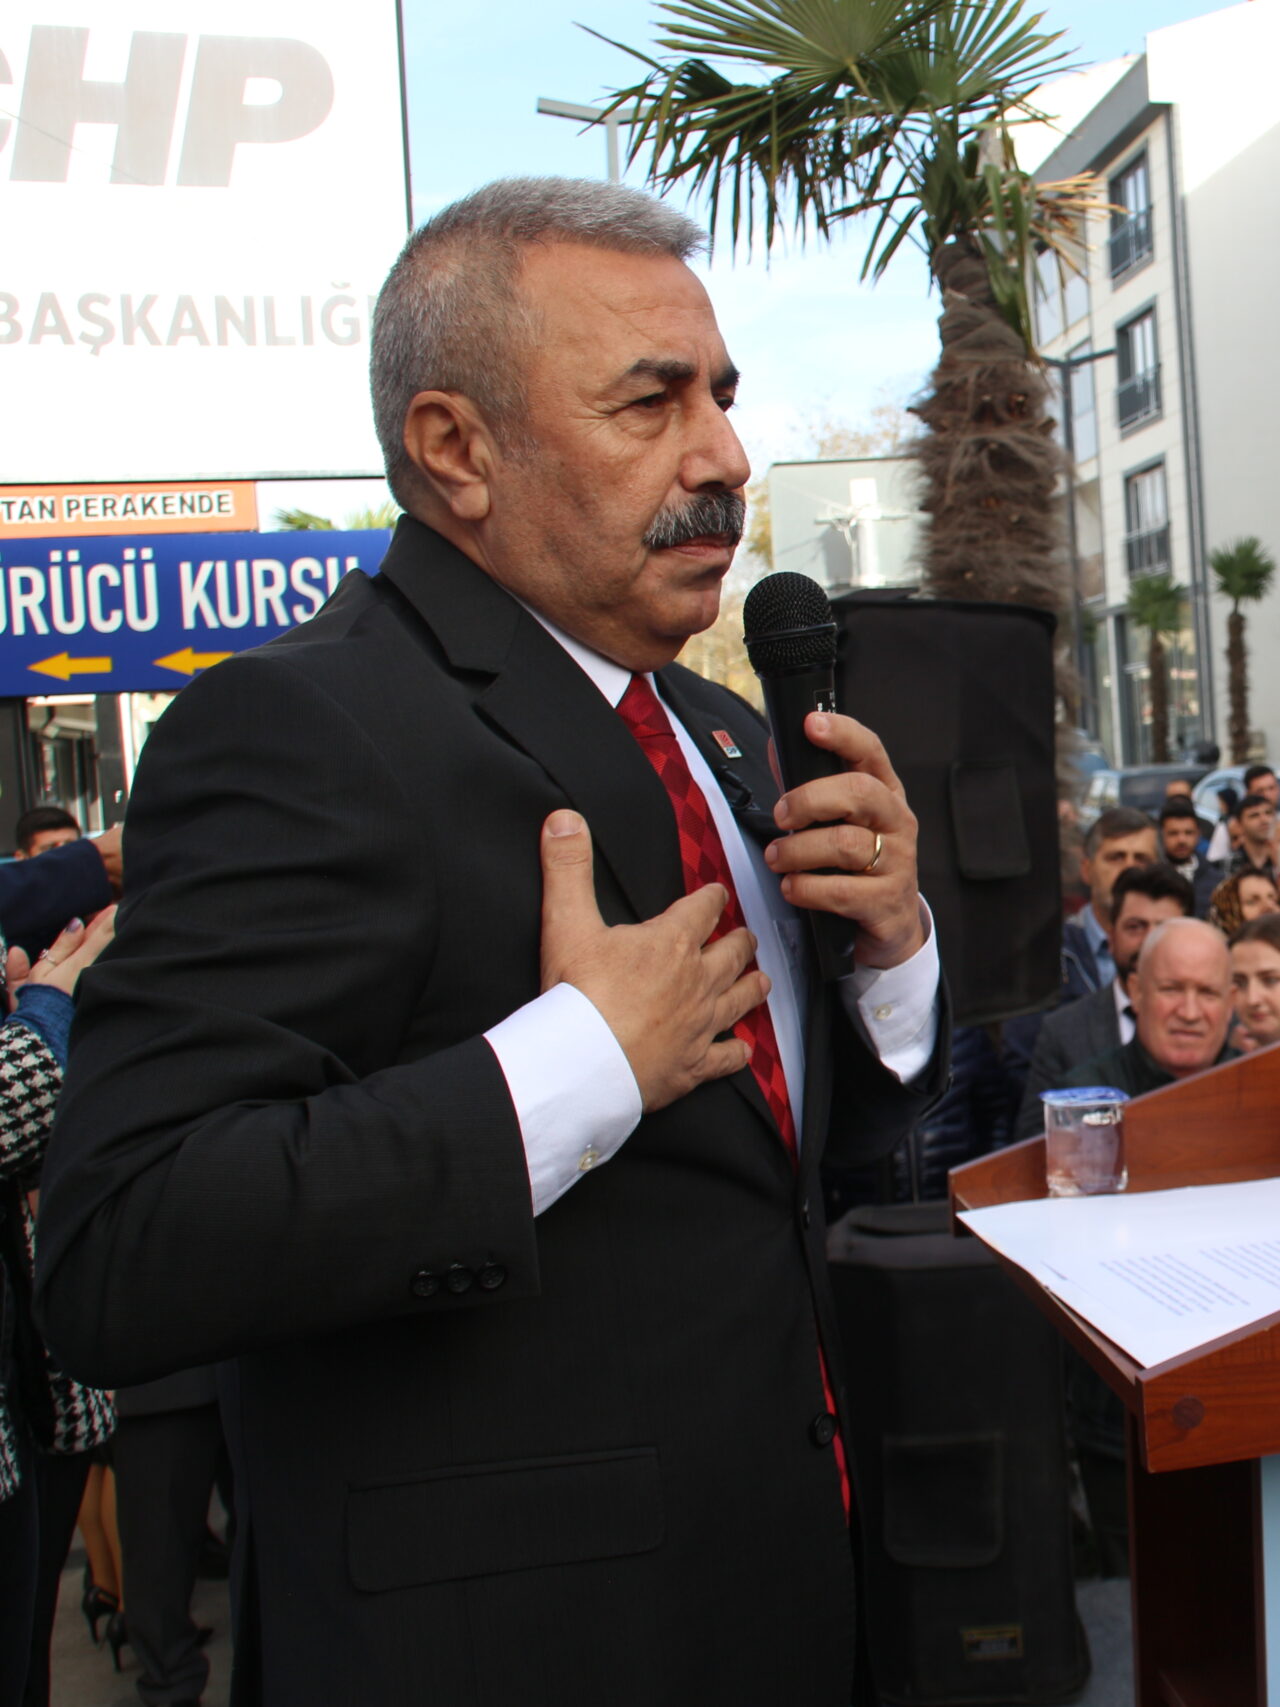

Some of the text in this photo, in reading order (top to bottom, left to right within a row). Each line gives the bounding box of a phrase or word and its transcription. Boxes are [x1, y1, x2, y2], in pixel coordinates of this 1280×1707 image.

[0, 24, 335, 187] HP
[67, 493, 232, 518] PERAKENDE
[0, 547, 159, 636] RÜCÜ
